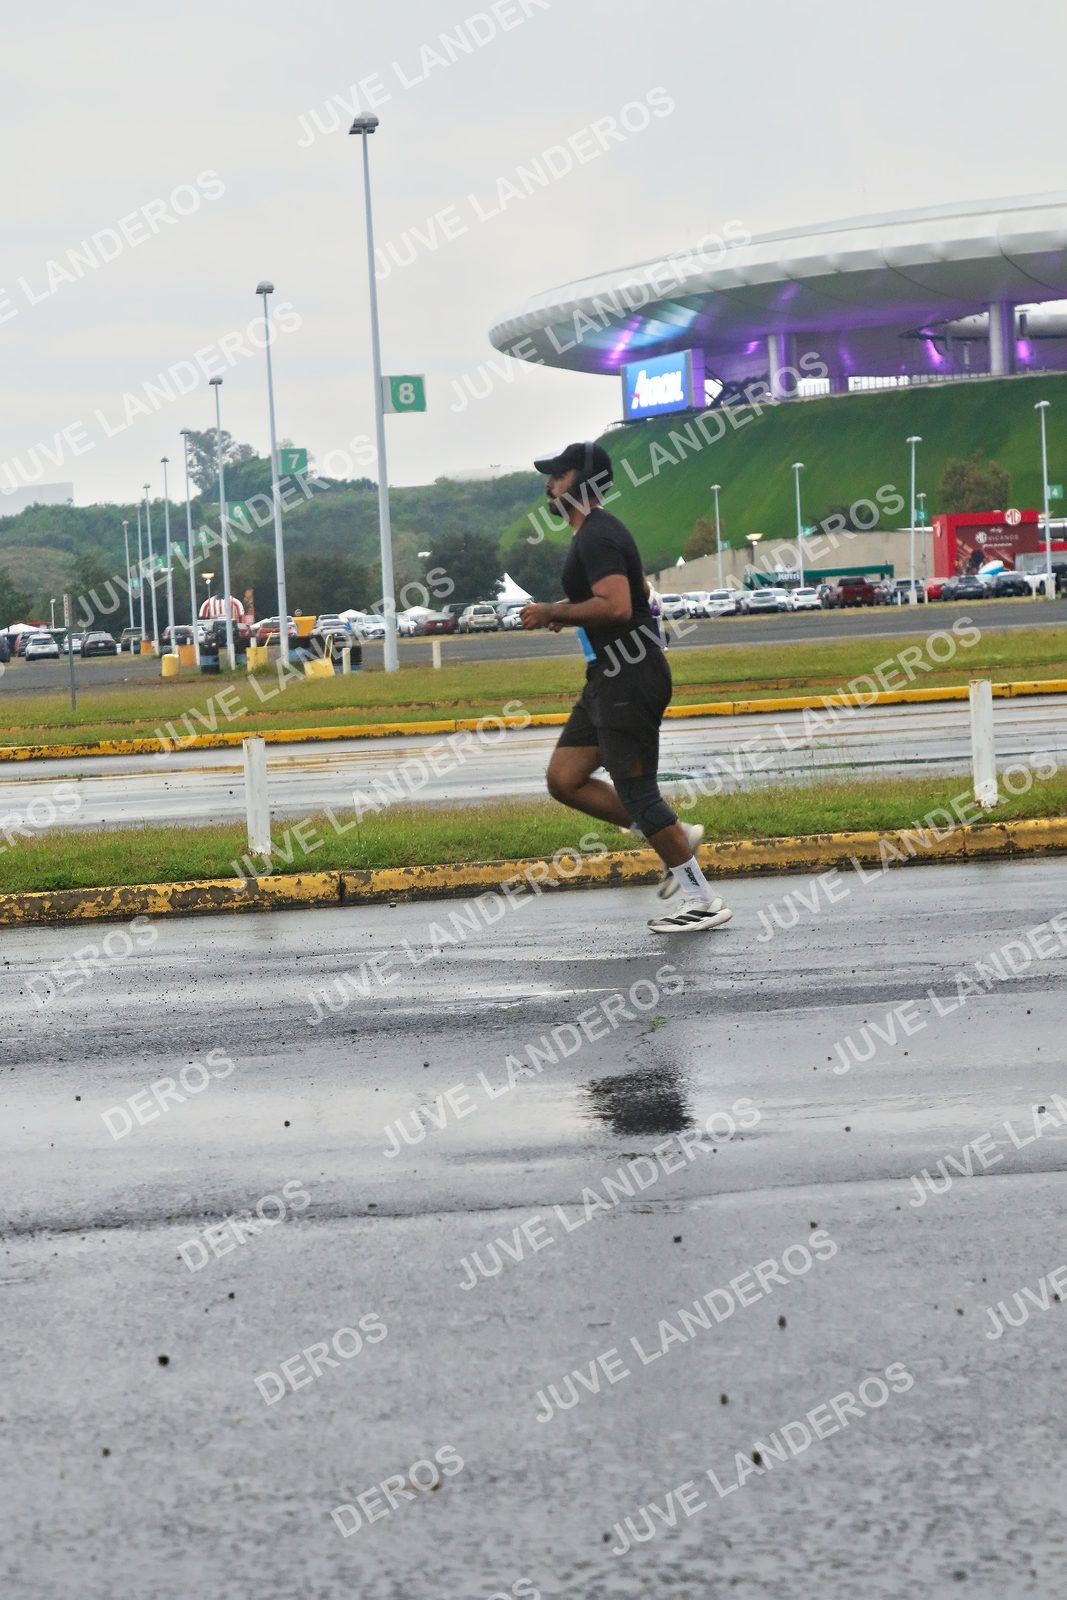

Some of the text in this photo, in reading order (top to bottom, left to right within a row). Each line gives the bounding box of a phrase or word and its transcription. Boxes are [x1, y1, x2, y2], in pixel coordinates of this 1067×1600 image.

[399, 382, 415, 404] 8
[288, 453, 300, 468] 7
[1005, 508, 1021, 525] MG
